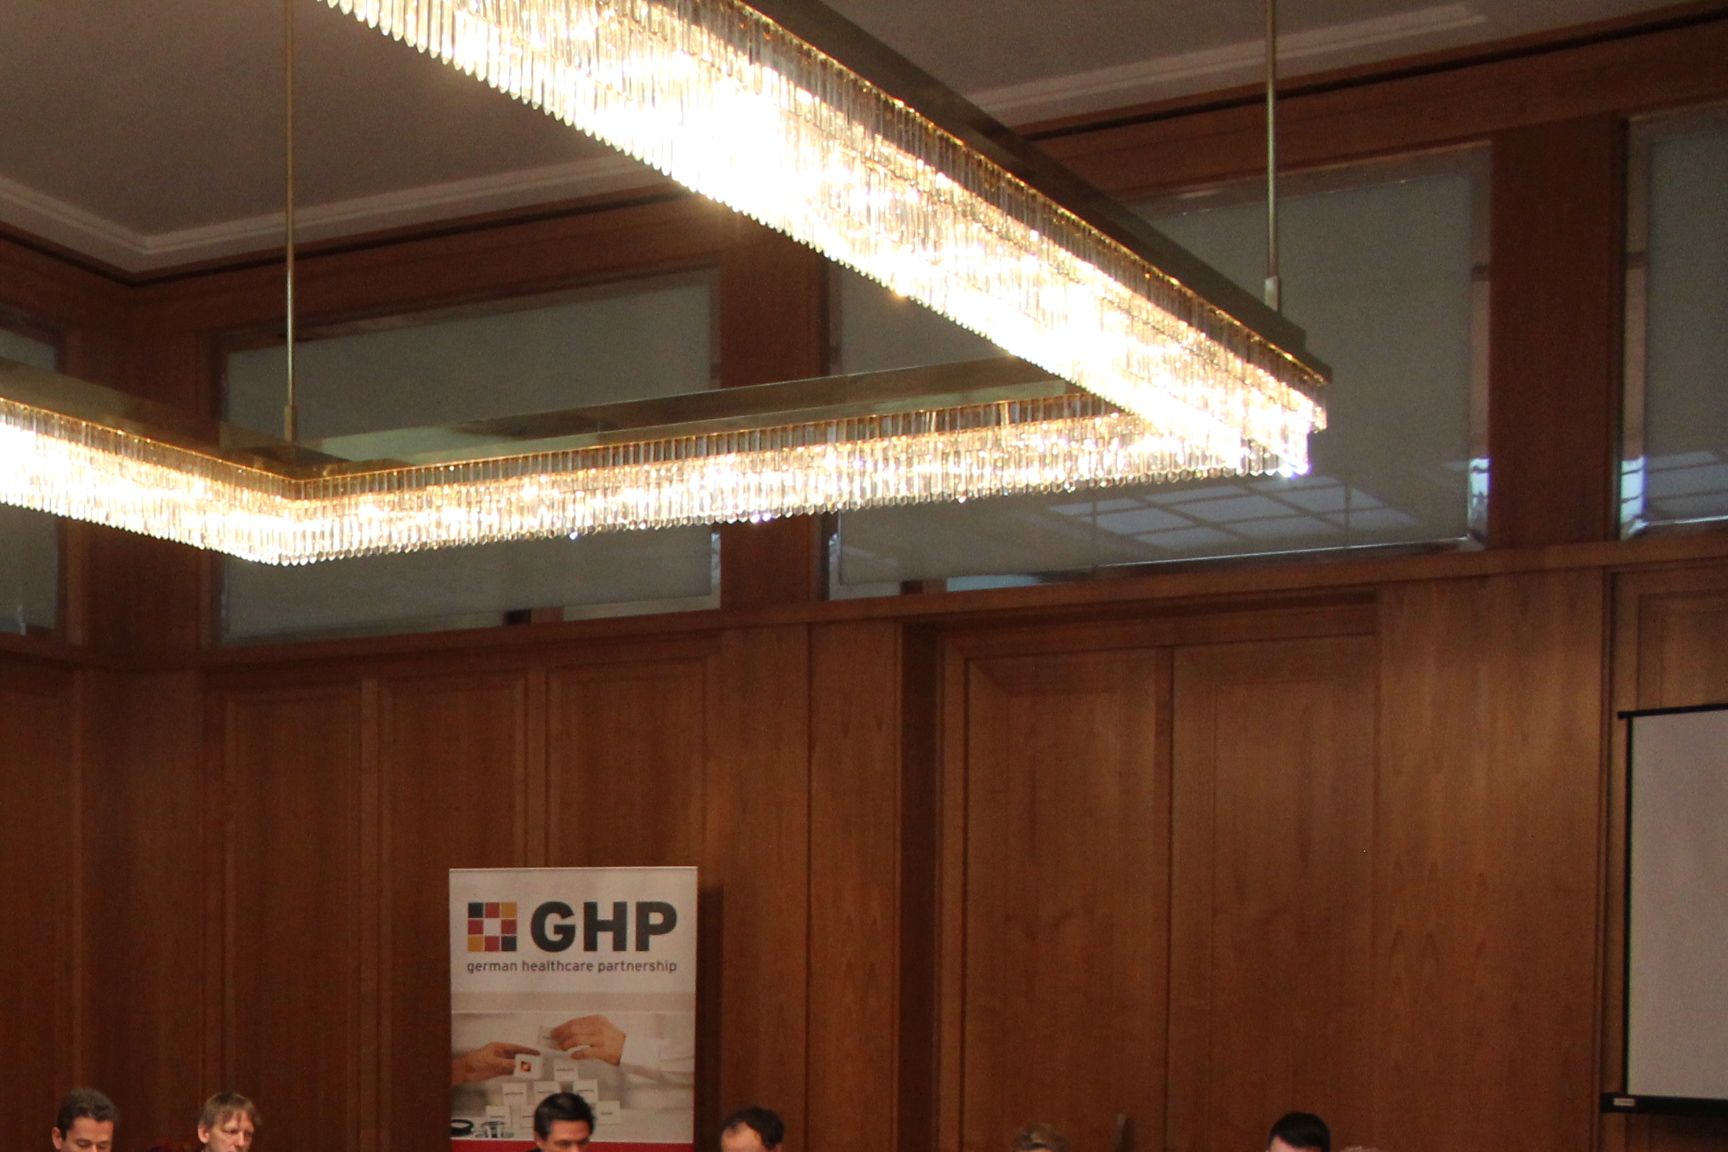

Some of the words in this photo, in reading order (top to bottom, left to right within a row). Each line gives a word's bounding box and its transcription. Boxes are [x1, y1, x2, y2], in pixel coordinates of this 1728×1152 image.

[530, 901, 677, 953] GHP
[467, 961, 518, 974] german
[522, 960, 594, 972] healthcare
[598, 960, 677, 974] partnership
